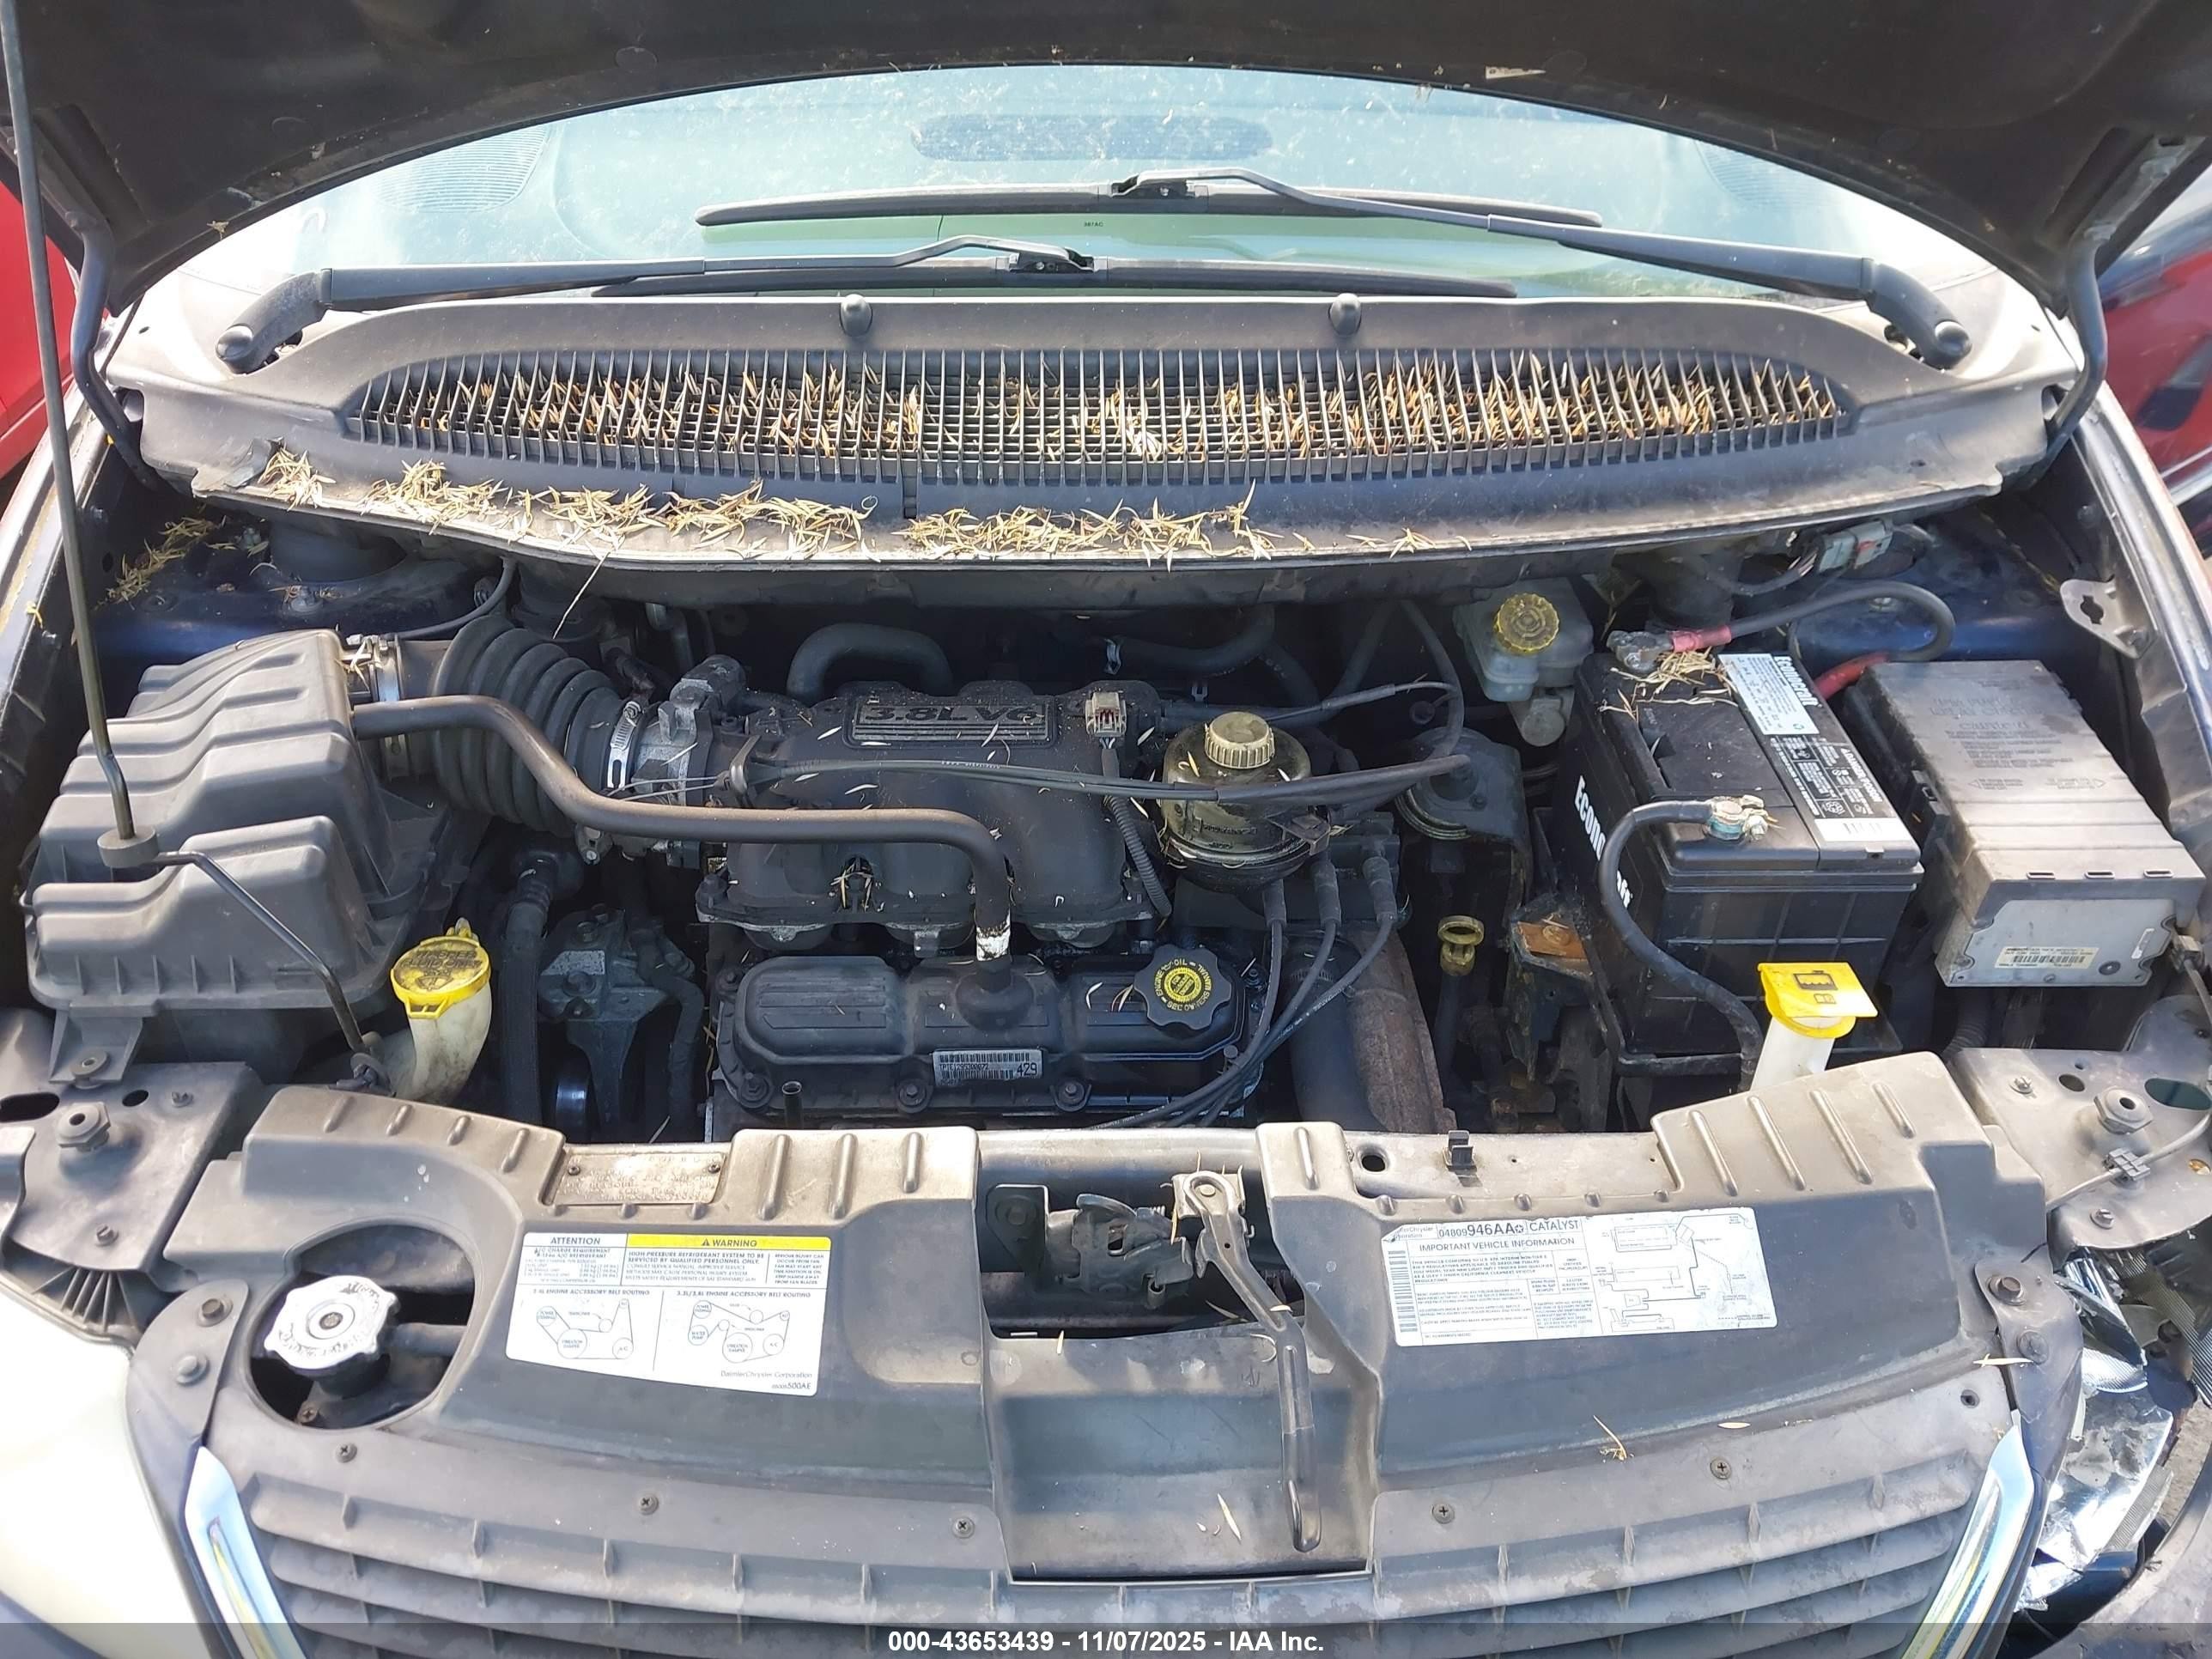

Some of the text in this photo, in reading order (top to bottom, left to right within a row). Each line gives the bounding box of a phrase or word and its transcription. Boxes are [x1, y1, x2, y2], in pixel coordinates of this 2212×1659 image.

[1016, 1061, 1038, 1078] 429
[1437, 1222, 1516, 1239] 04809946AA
[1528, 1219, 1579, 1231] CATALYST
[550, 1237, 601, 1246] ATTENTION
[712, 1238, 758, 1249] WARNING
[1419, 1237, 1575, 1252] IMPORTANT VEHICLE INFORMATION
